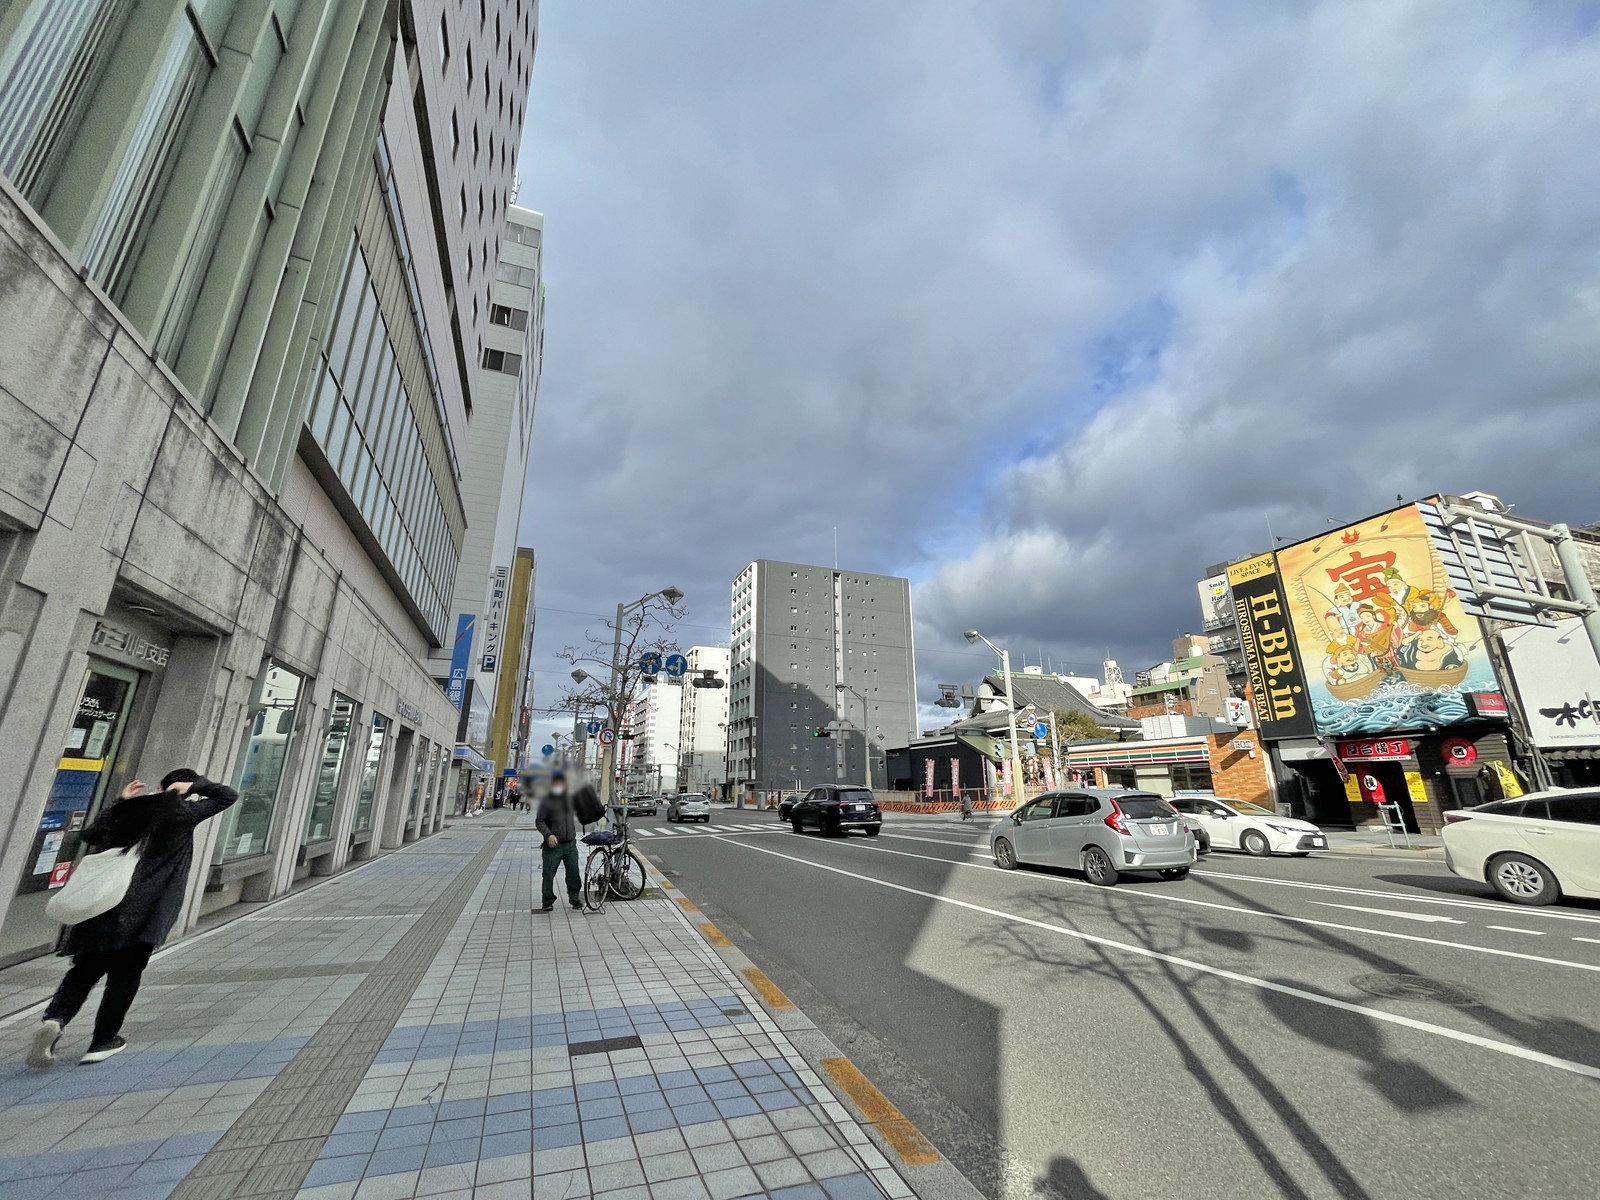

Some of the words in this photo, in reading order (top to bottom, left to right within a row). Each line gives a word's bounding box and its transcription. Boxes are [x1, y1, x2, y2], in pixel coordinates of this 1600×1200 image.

[1209, 580, 1226, 588] Smile
[1230, 567, 1245, 576] LIVE
[1241, 568, 1261, 578] SPACE
[1325, 551, 1398, 602] 宝
[486, 569, 506, 652] 三川町パーキング
[1235, 598, 1256, 662] HIROSHIMA
[1249, 663, 1263, 692] BACK
[1256, 693, 1270, 722] BEAT
[1250, 589, 1302, 721] H-BB.in
[449, 668, 465, 707] 広島銀
[1345, 741, 1404, 755] 屋台横丁
